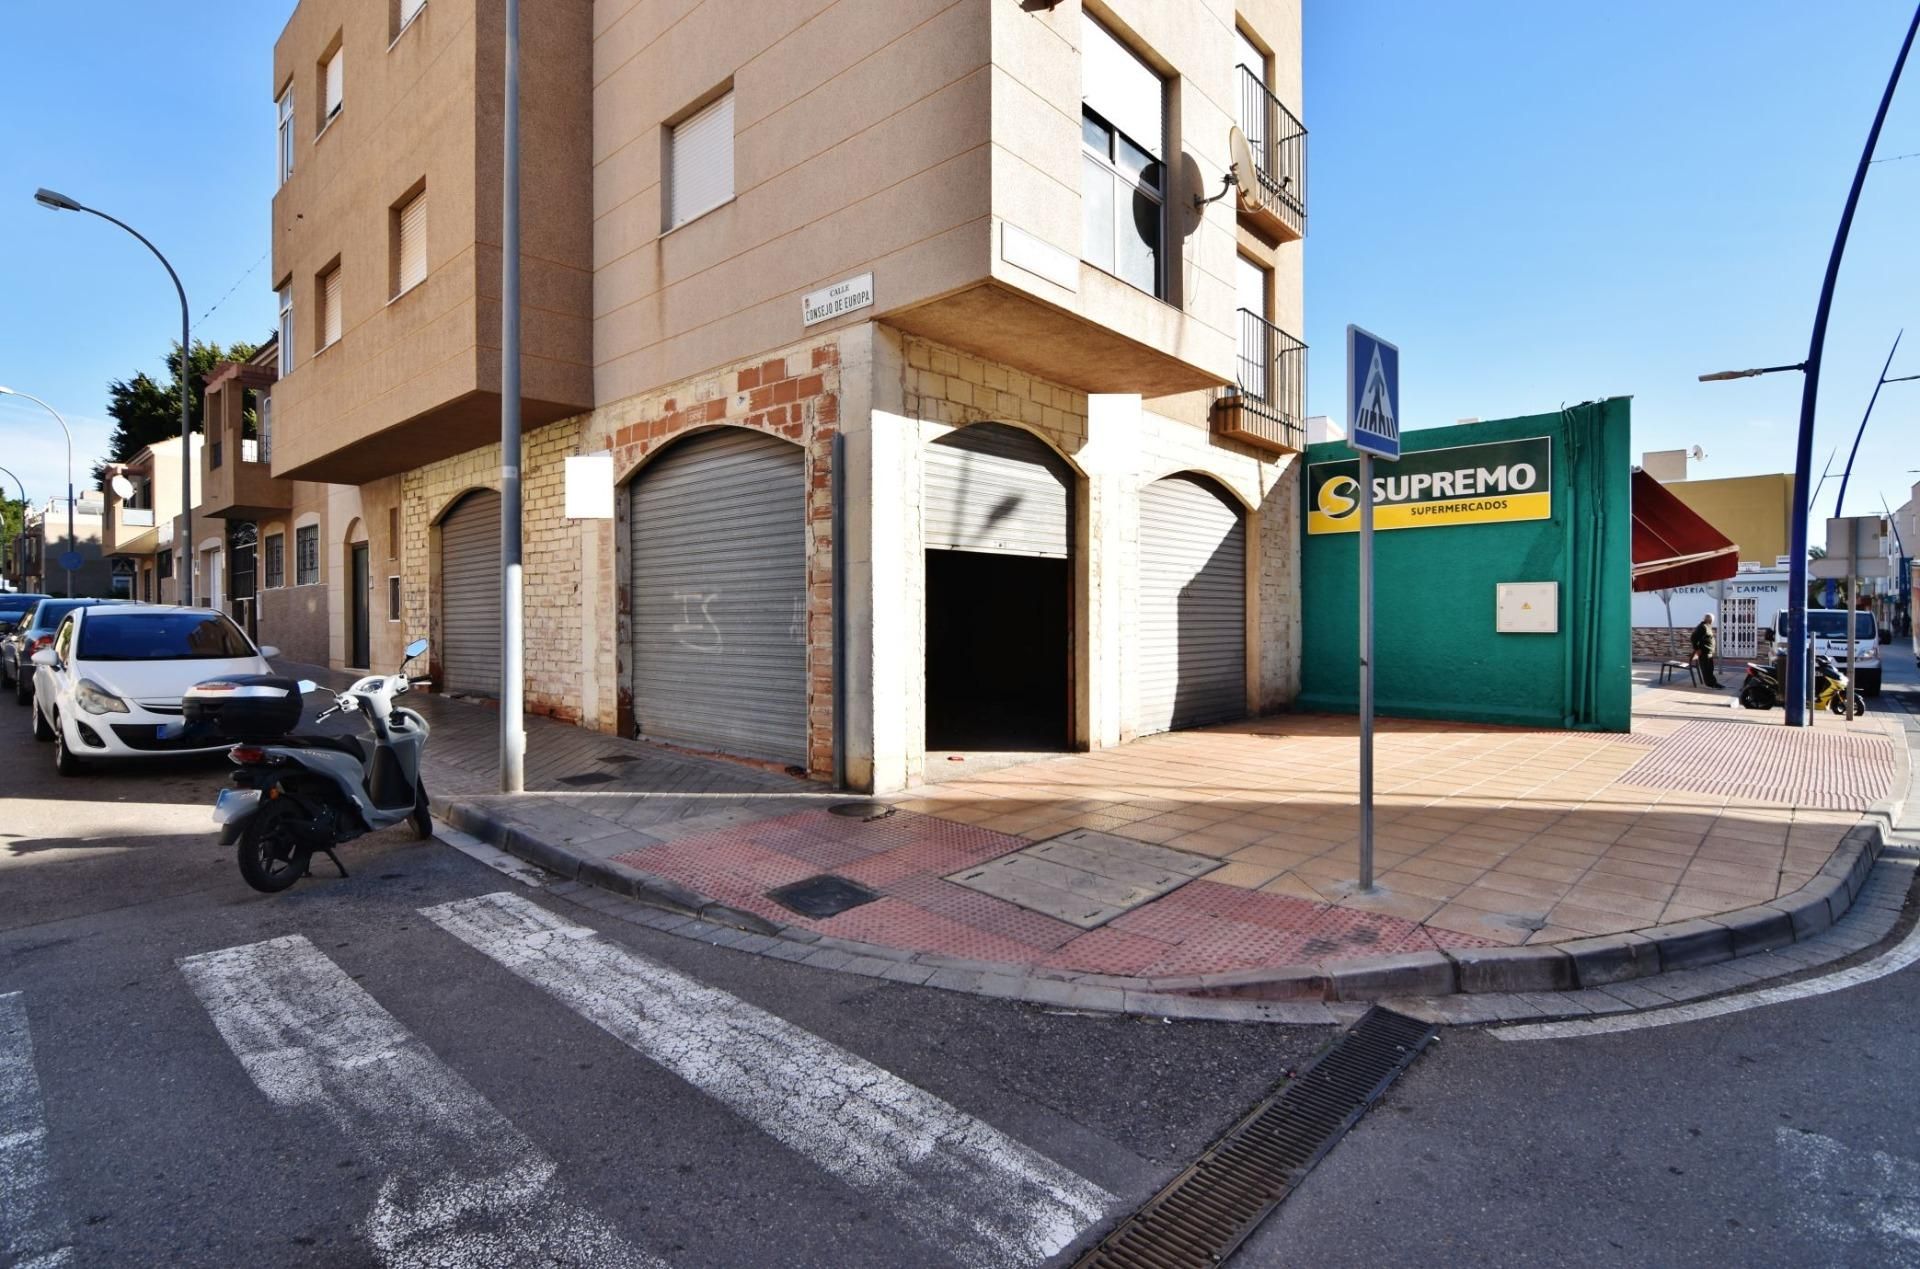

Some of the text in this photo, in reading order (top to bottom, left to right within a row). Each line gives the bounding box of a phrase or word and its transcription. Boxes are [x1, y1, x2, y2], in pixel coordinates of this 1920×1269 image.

[829, 284, 850, 297] CALLE
[805, 290, 870, 321] CONSEJO DE EUROPA
[1372, 463, 1536, 503] SUPREMO
[1410, 500, 1508, 516] SUPERMERCADOS
[1736, 585, 1778, 593] CARMEN
